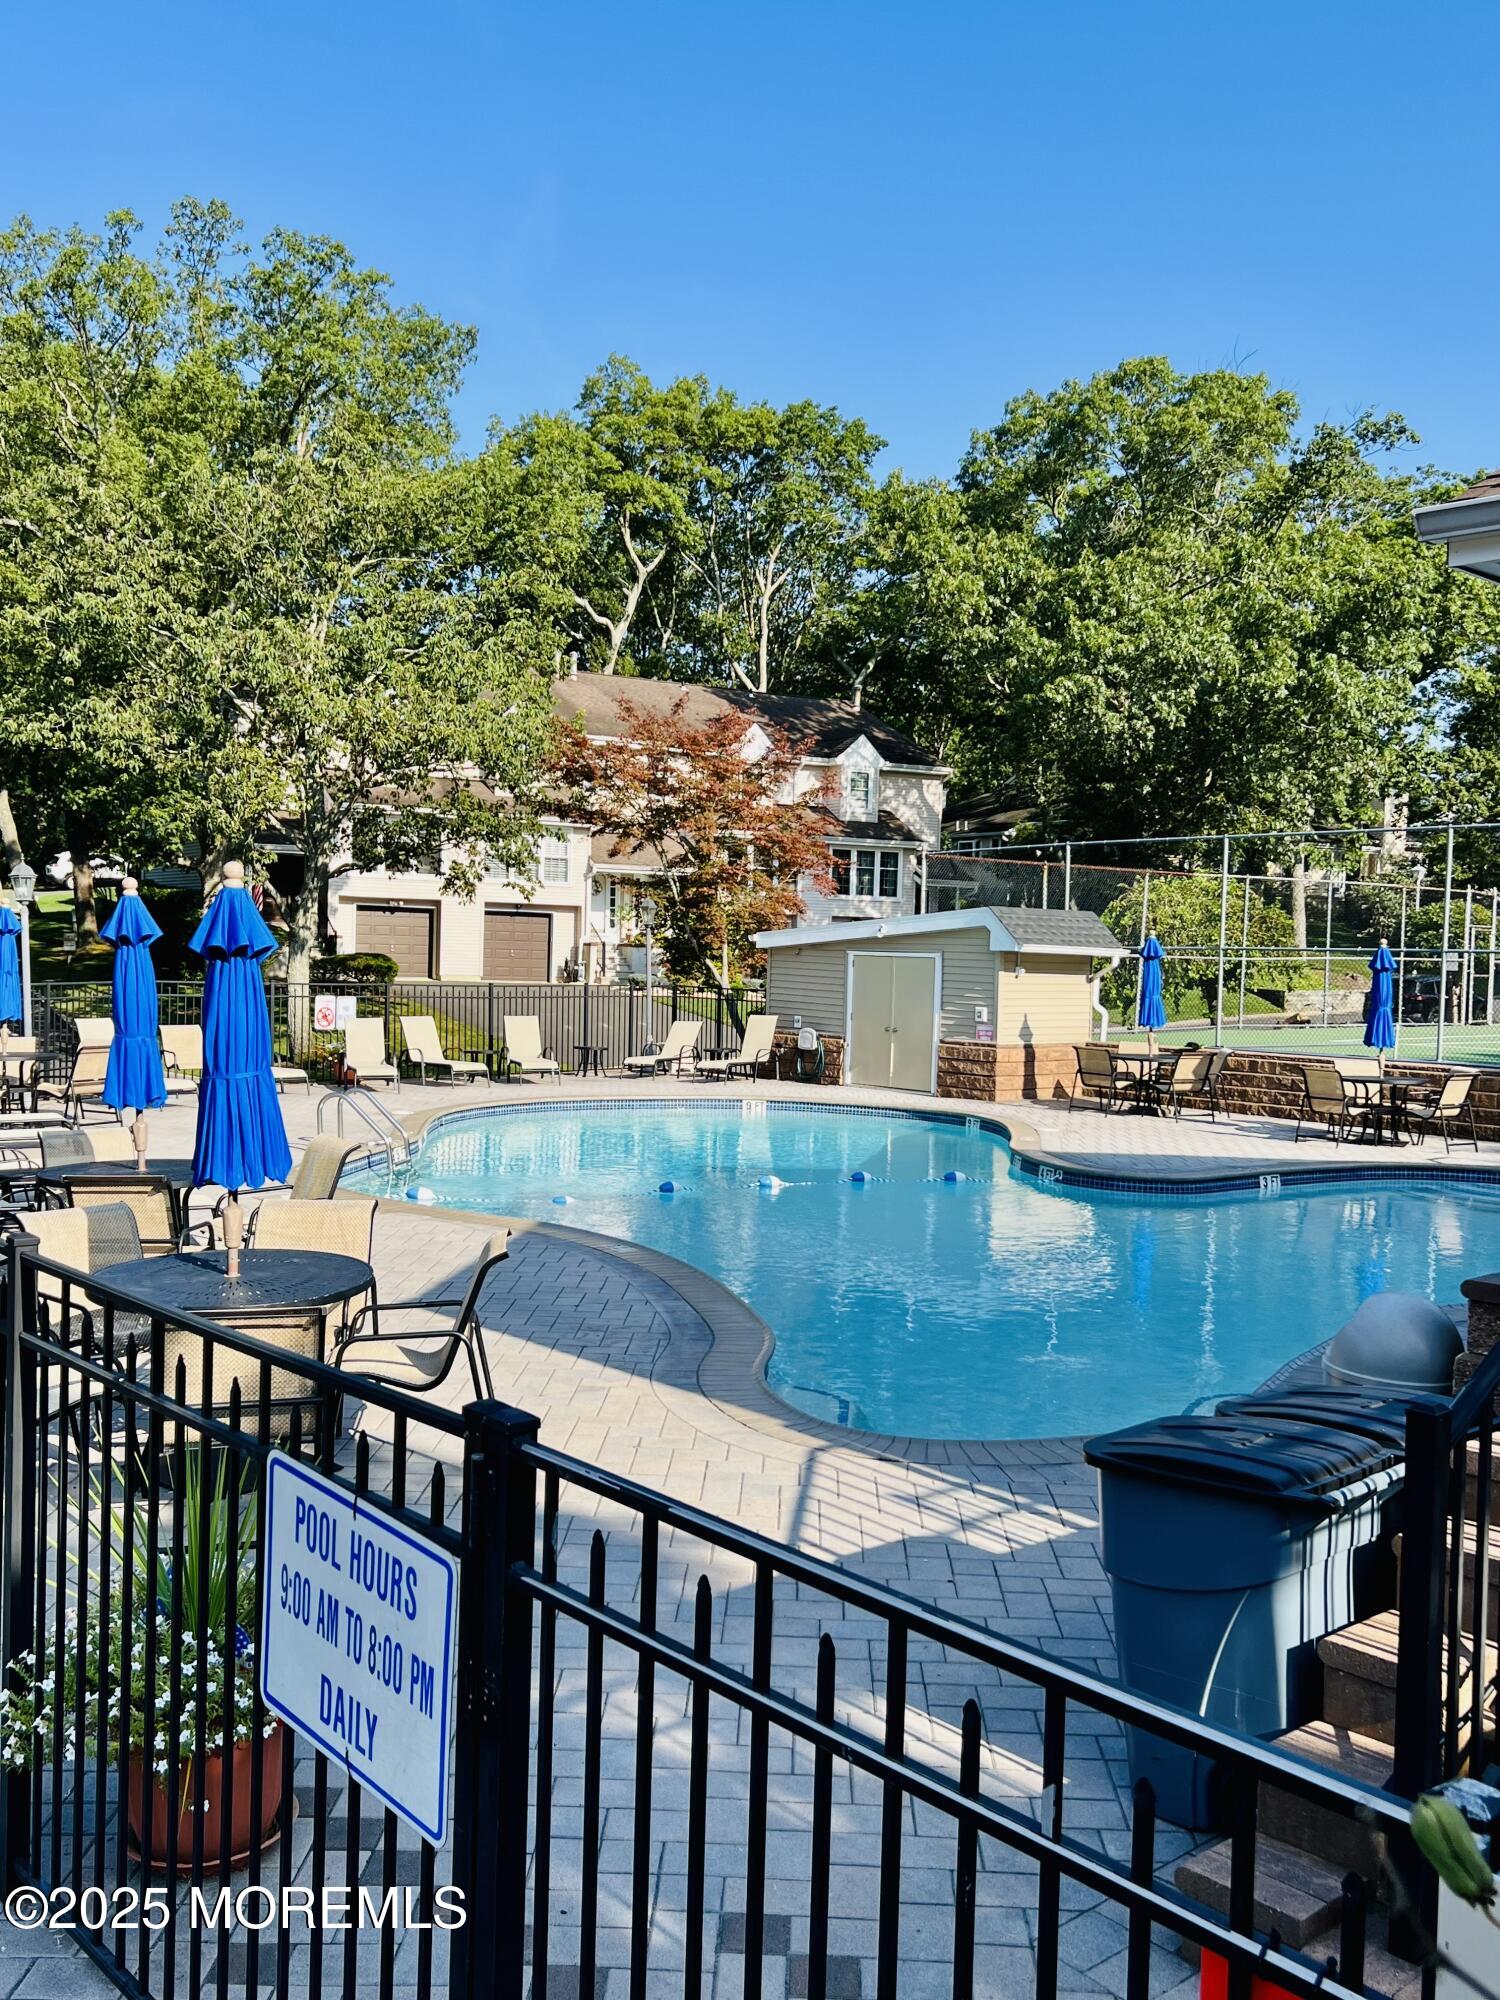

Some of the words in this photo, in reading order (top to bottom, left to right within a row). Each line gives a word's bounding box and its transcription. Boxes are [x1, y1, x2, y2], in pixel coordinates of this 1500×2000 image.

[1262, 1176, 1268, 1188] 3
[1270, 1175, 1279, 1189] FT
[295, 1495, 342, 1572] POOL
[349, 1529, 418, 1621] HOURS
[280, 1563, 311, 1627] 9:00
[316, 1587, 340, 1649] AM
[344, 1605, 363, 1665] TO
[367, 1624, 403, 1695] 8:00
[409, 1652, 435, 1720] PM
[319, 1673, 378, 1762] DAILY
